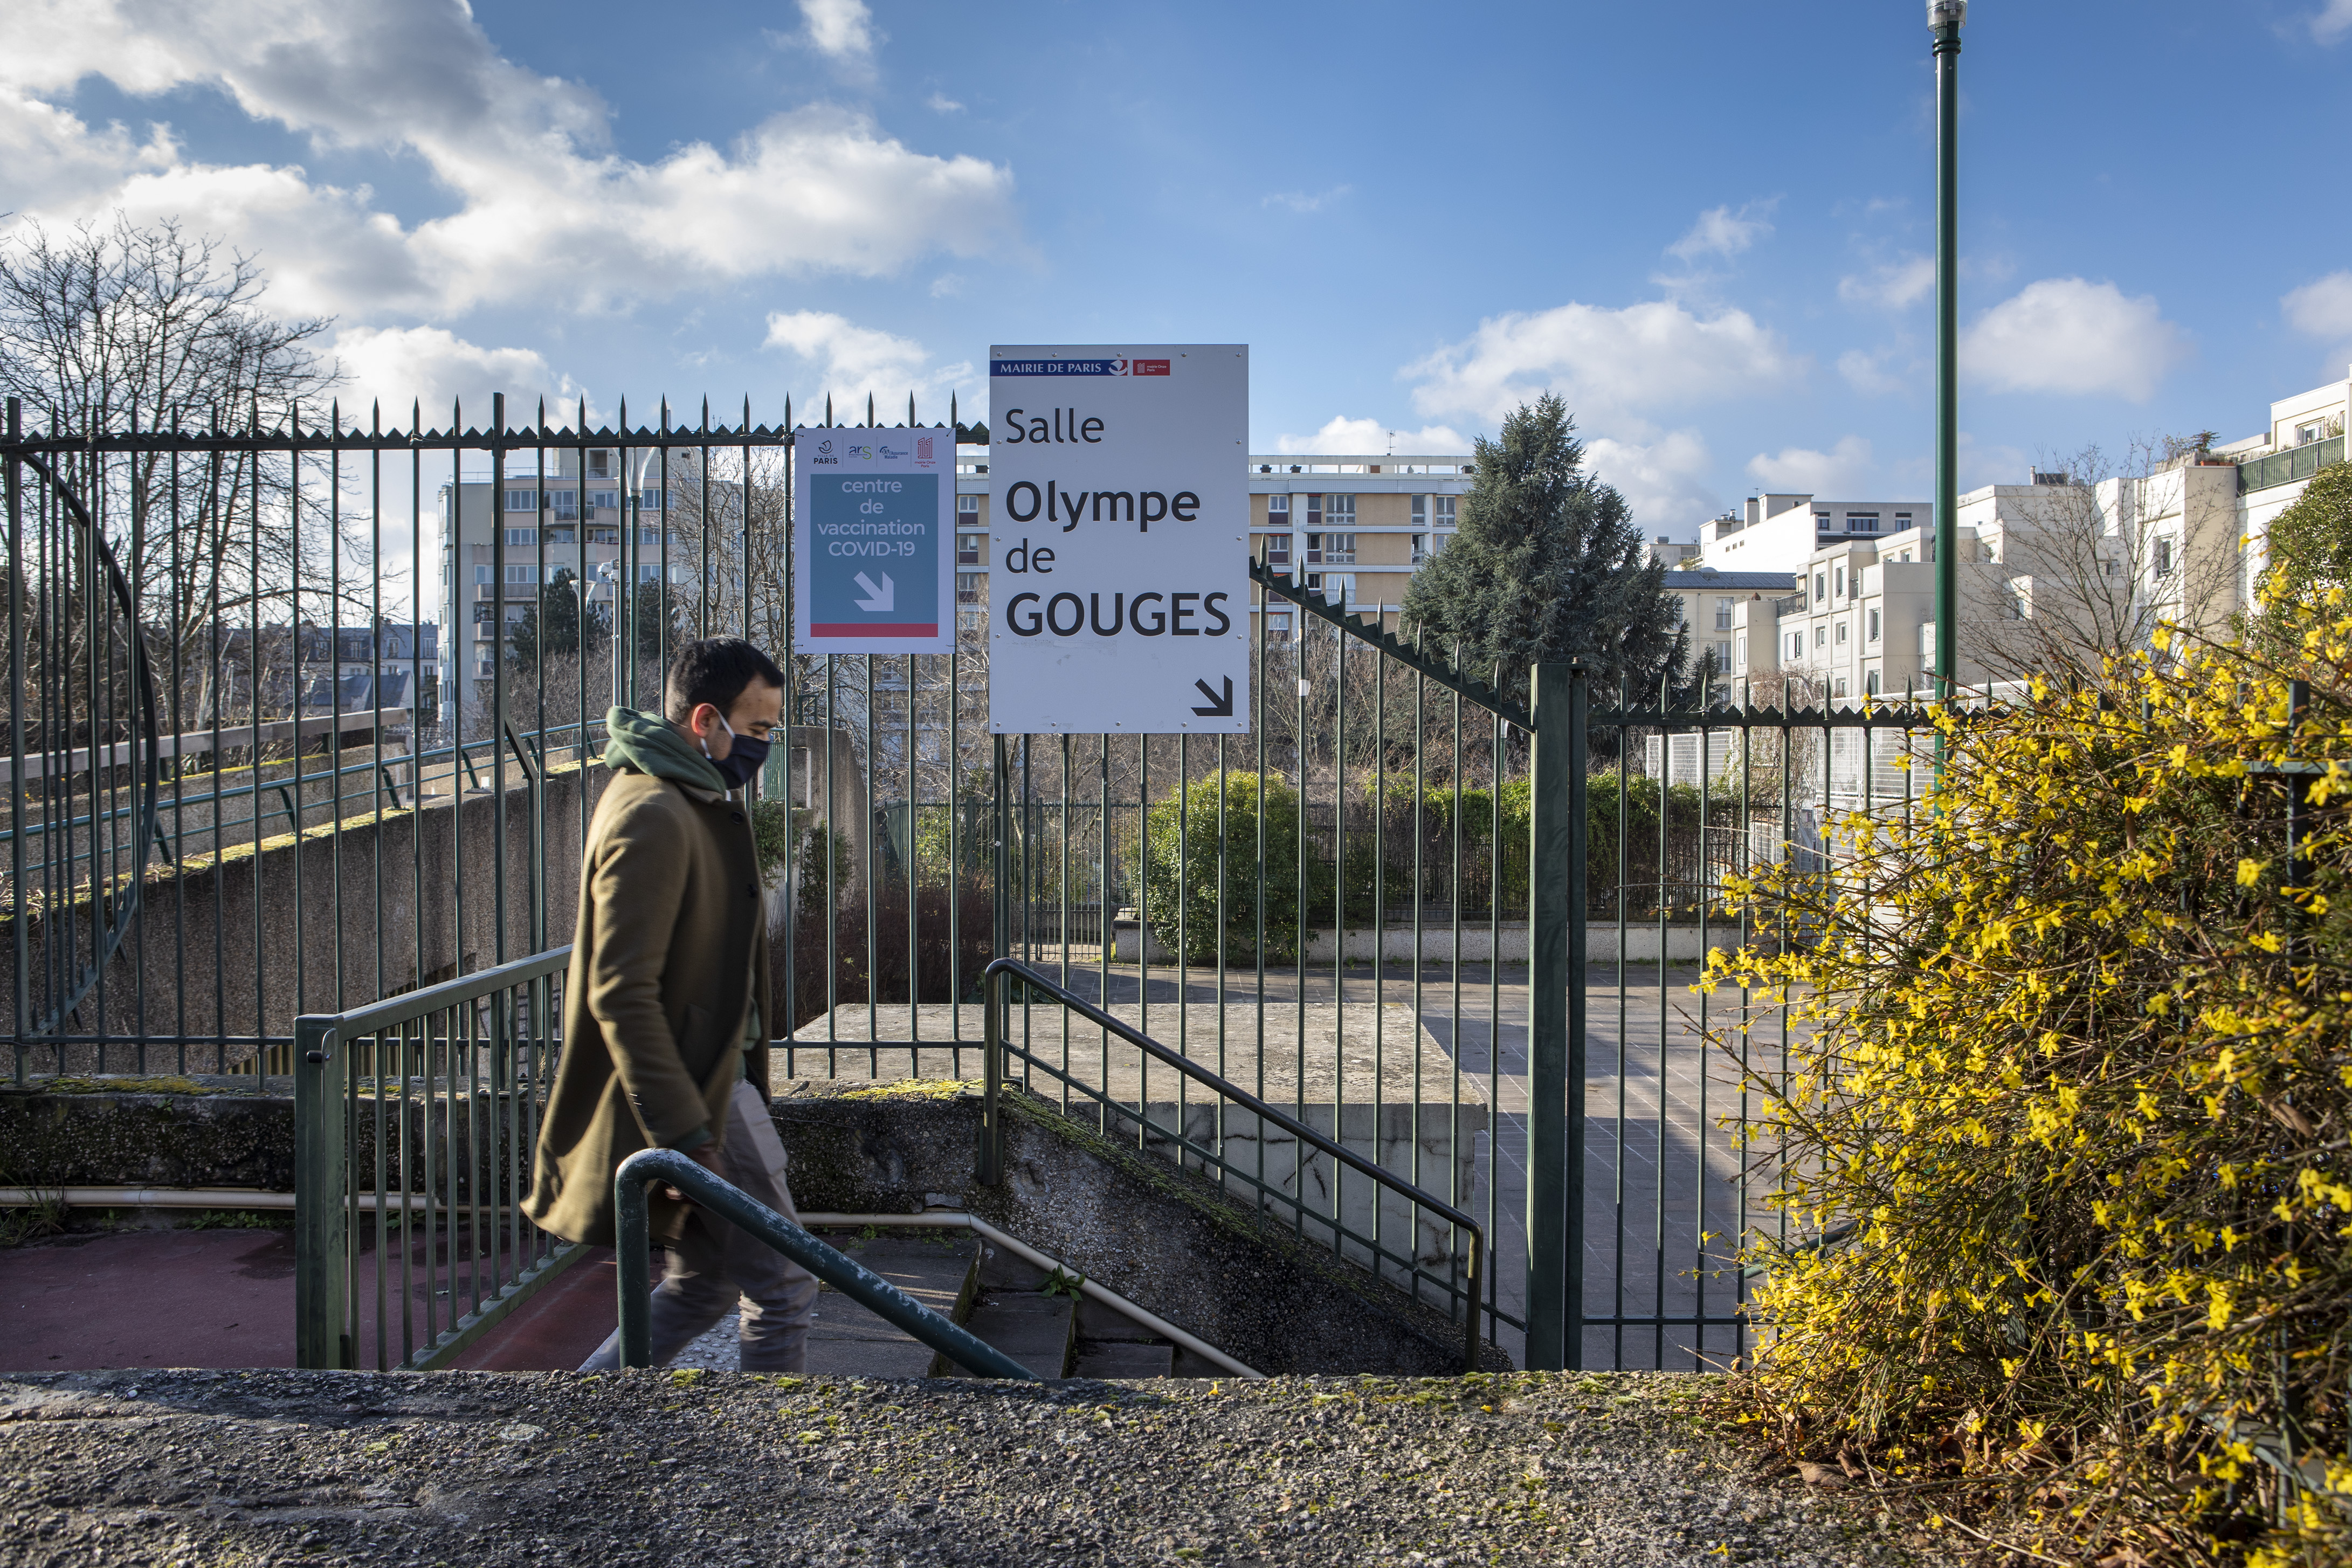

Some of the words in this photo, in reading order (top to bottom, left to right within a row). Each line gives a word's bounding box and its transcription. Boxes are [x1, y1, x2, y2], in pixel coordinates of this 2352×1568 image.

[1001, 363, 1044, 373] MAIRIE
[1047, 363, 1064, 372] DE
[1068, 363, 1101, 372] PARIS
[1005, 408, 1105, 444] Salle
[842, 479, 902, 493] centre
[860, 499, 884, 514] de
[1006, 480, 1201, 533] Olympe
[817, 519, 925, 535] vaccination
[829, 541, 915, 556] COVID-19
[1005, 537, 1056, 574] de
[1006, 592, 1231, 637] GOUGES
